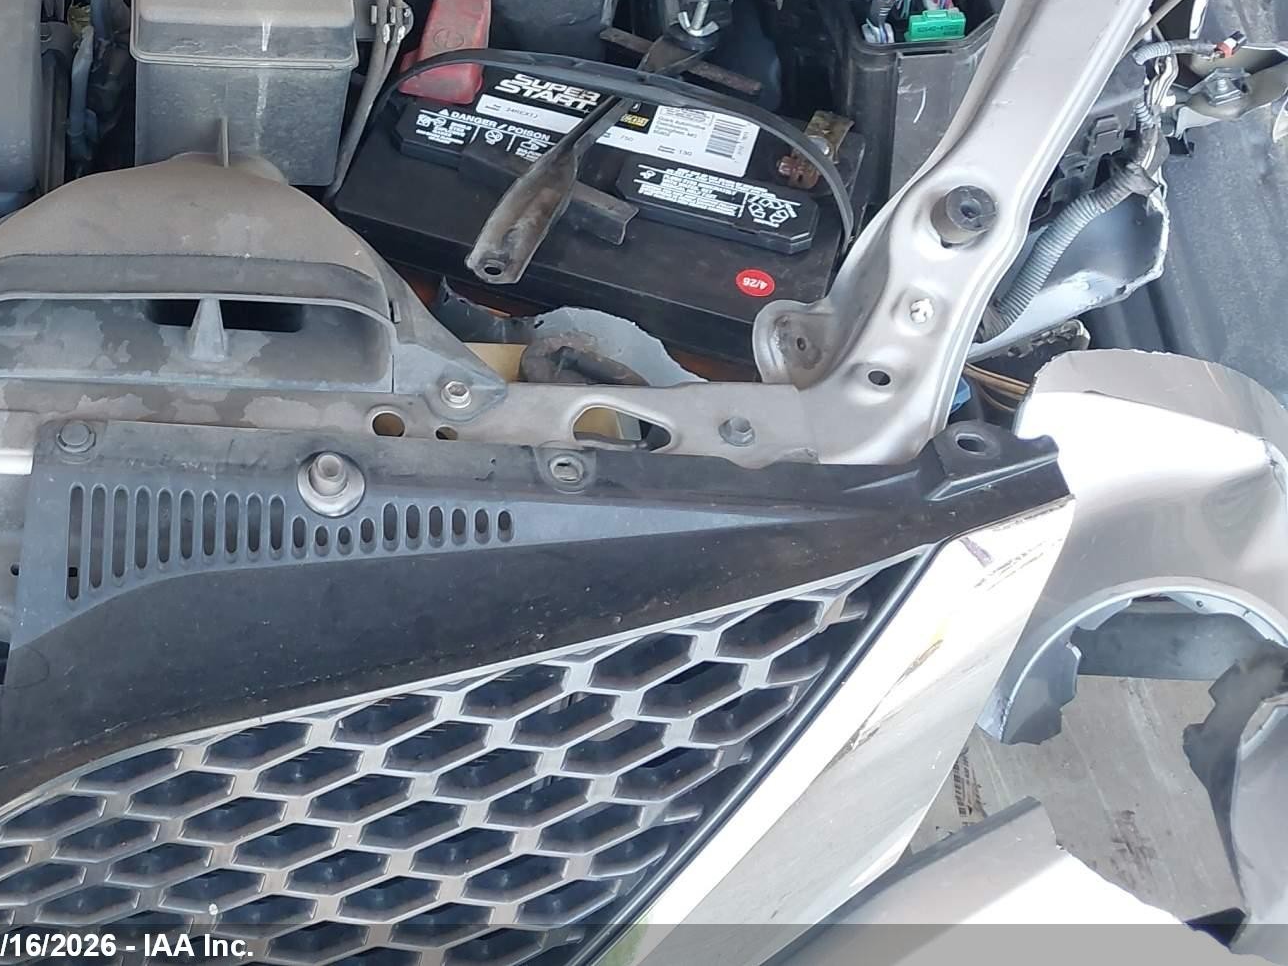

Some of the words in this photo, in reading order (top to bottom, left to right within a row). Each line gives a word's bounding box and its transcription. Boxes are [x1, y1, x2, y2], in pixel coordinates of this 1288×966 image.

[494, 79, 597, 110] START
[513, 73, 601, 102] SUPER
[451, 111, 498, 128] DANGER
[508, 125, 551, 141] POISON
[743, 277, 768, 290] 4/26
